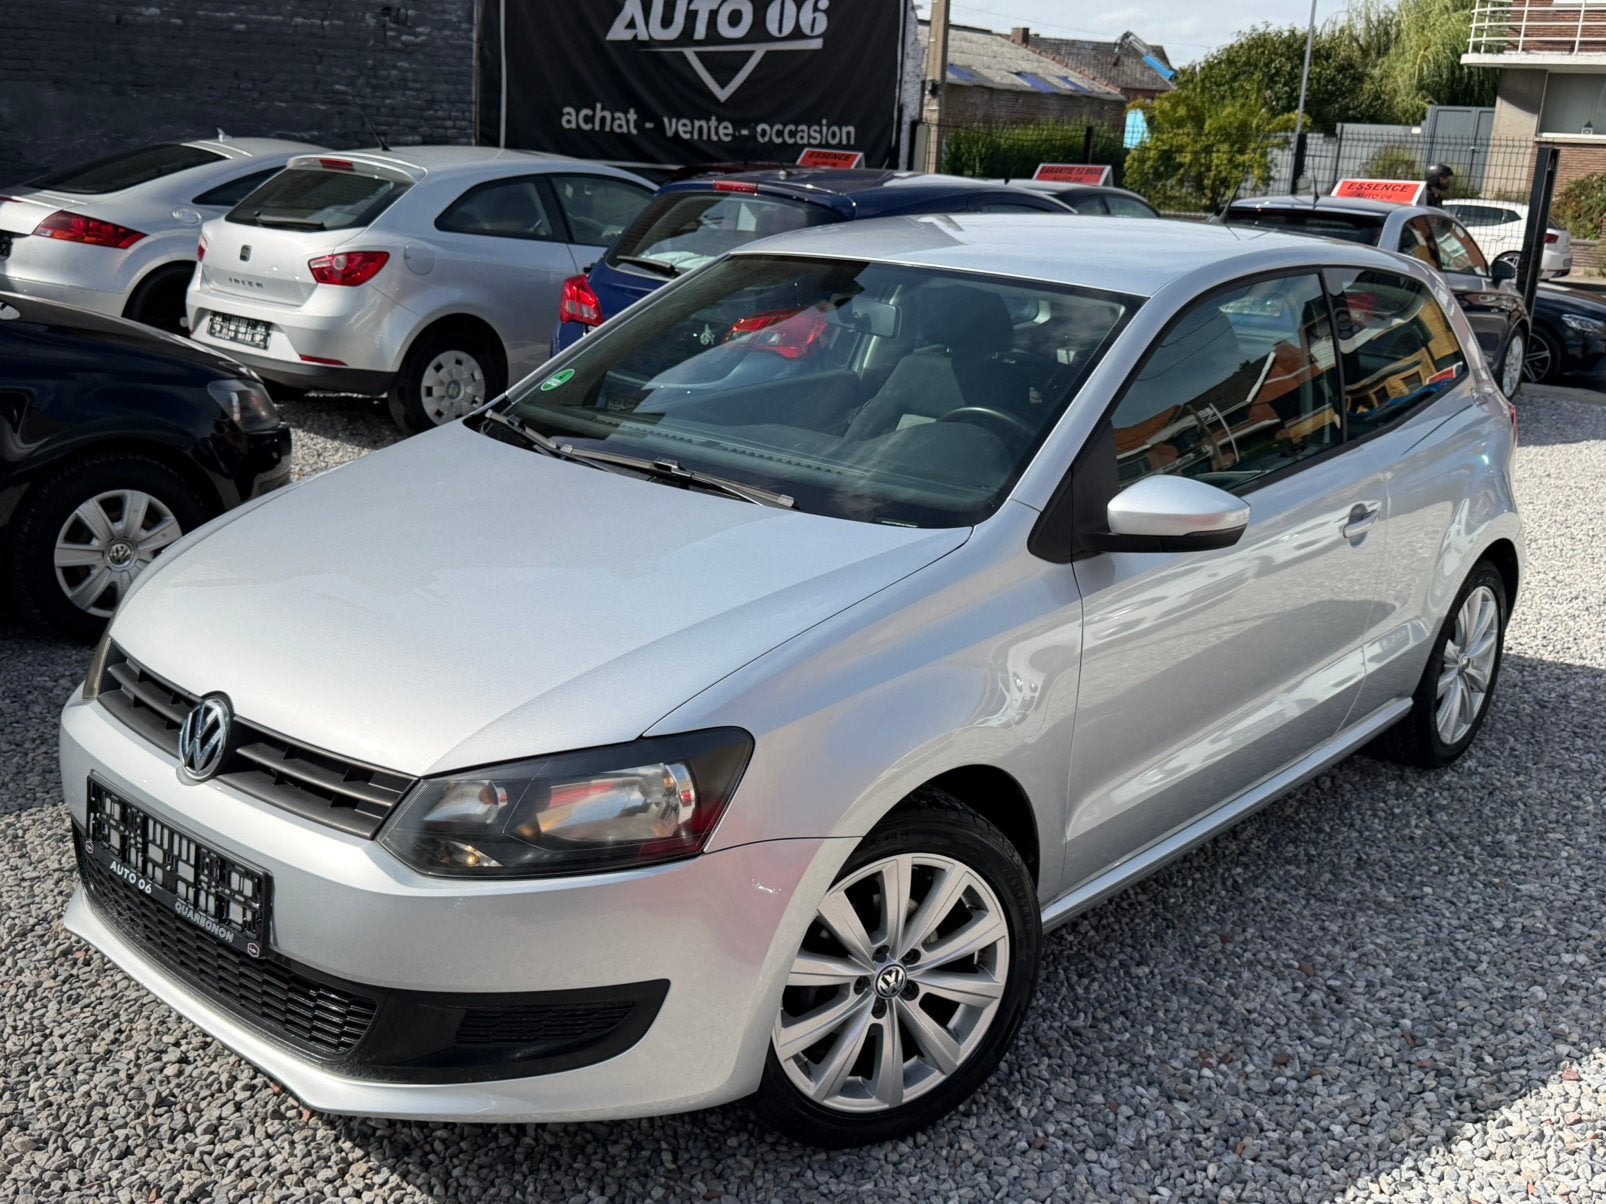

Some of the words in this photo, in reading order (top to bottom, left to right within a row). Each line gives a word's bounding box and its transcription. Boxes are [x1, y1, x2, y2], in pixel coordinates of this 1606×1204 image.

[605, 0, 753, 41] AUTO
[766, 0, 830, 38] 06
[561, 102, 638, 135] achat
[663, 115, 733, 142] vente
[756, 119, 856, 145] occasion
[808, 151, 851, 162] ESSENCE
[1346, 182, 1411, 193] ESSENCE
[109, 860, 137, 884] AUTO
[138, 875, 152, 895] 06
